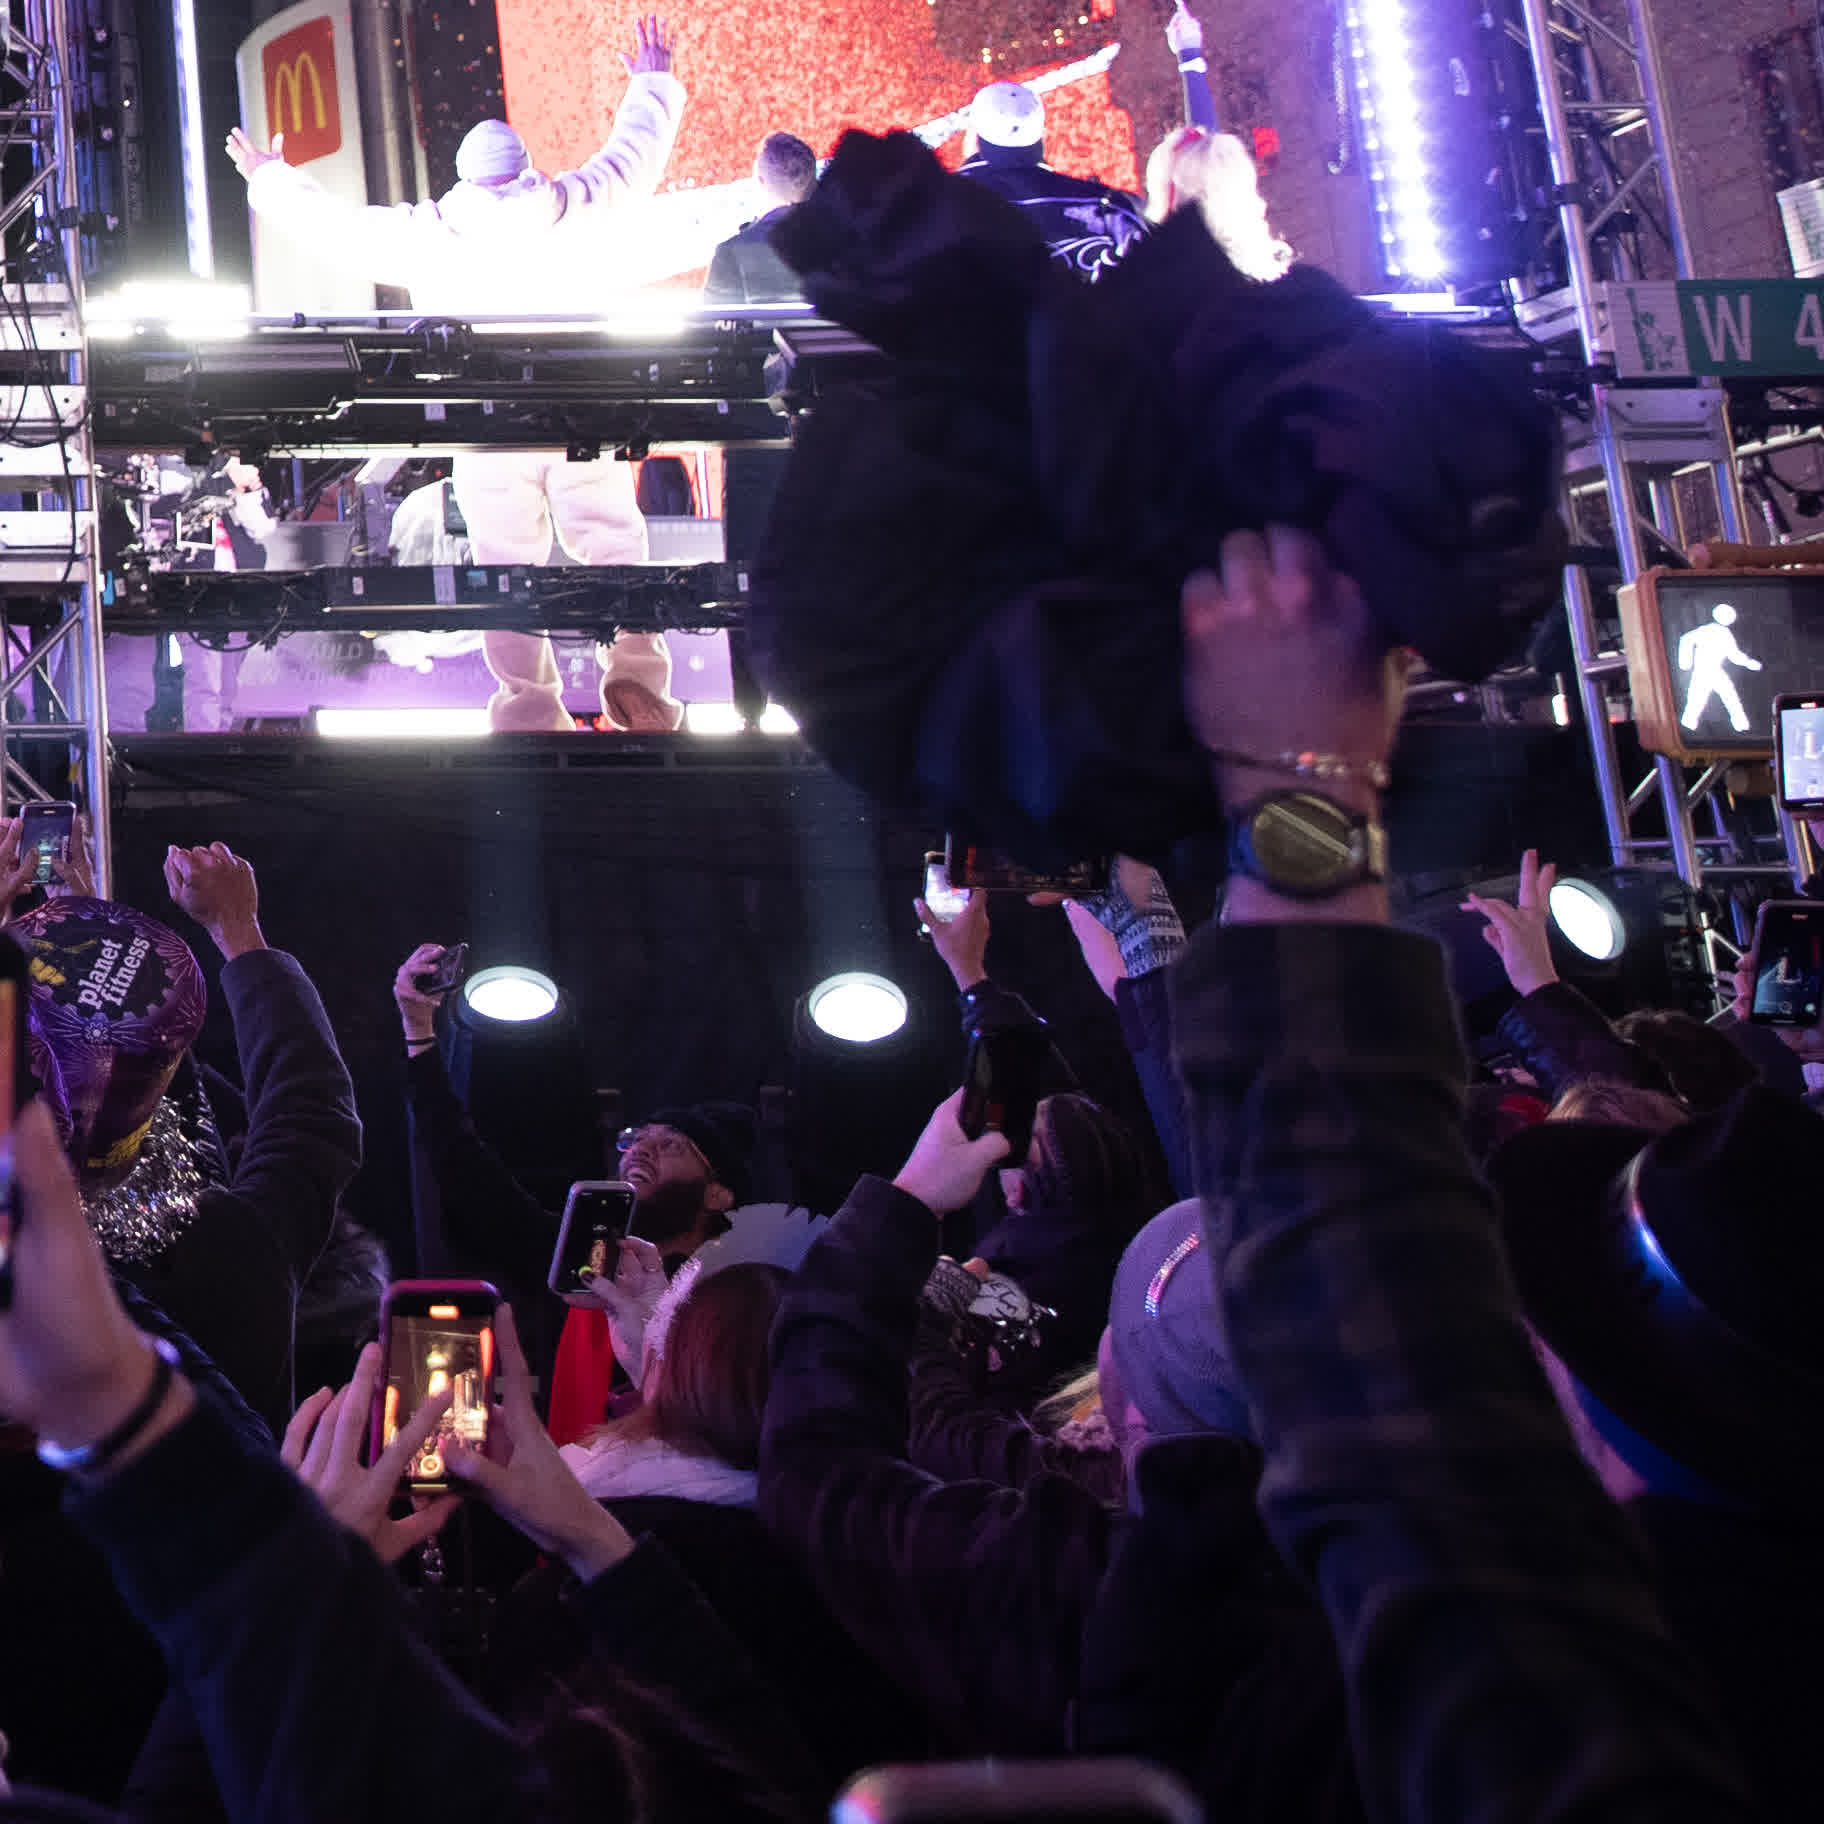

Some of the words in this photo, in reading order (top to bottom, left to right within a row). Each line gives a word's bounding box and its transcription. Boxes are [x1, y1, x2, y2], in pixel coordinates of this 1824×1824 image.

[1692, 293, 1753, 362] W
[78, 937, 123, 1011] planet
[101, 936, 151, 1007] fitness
